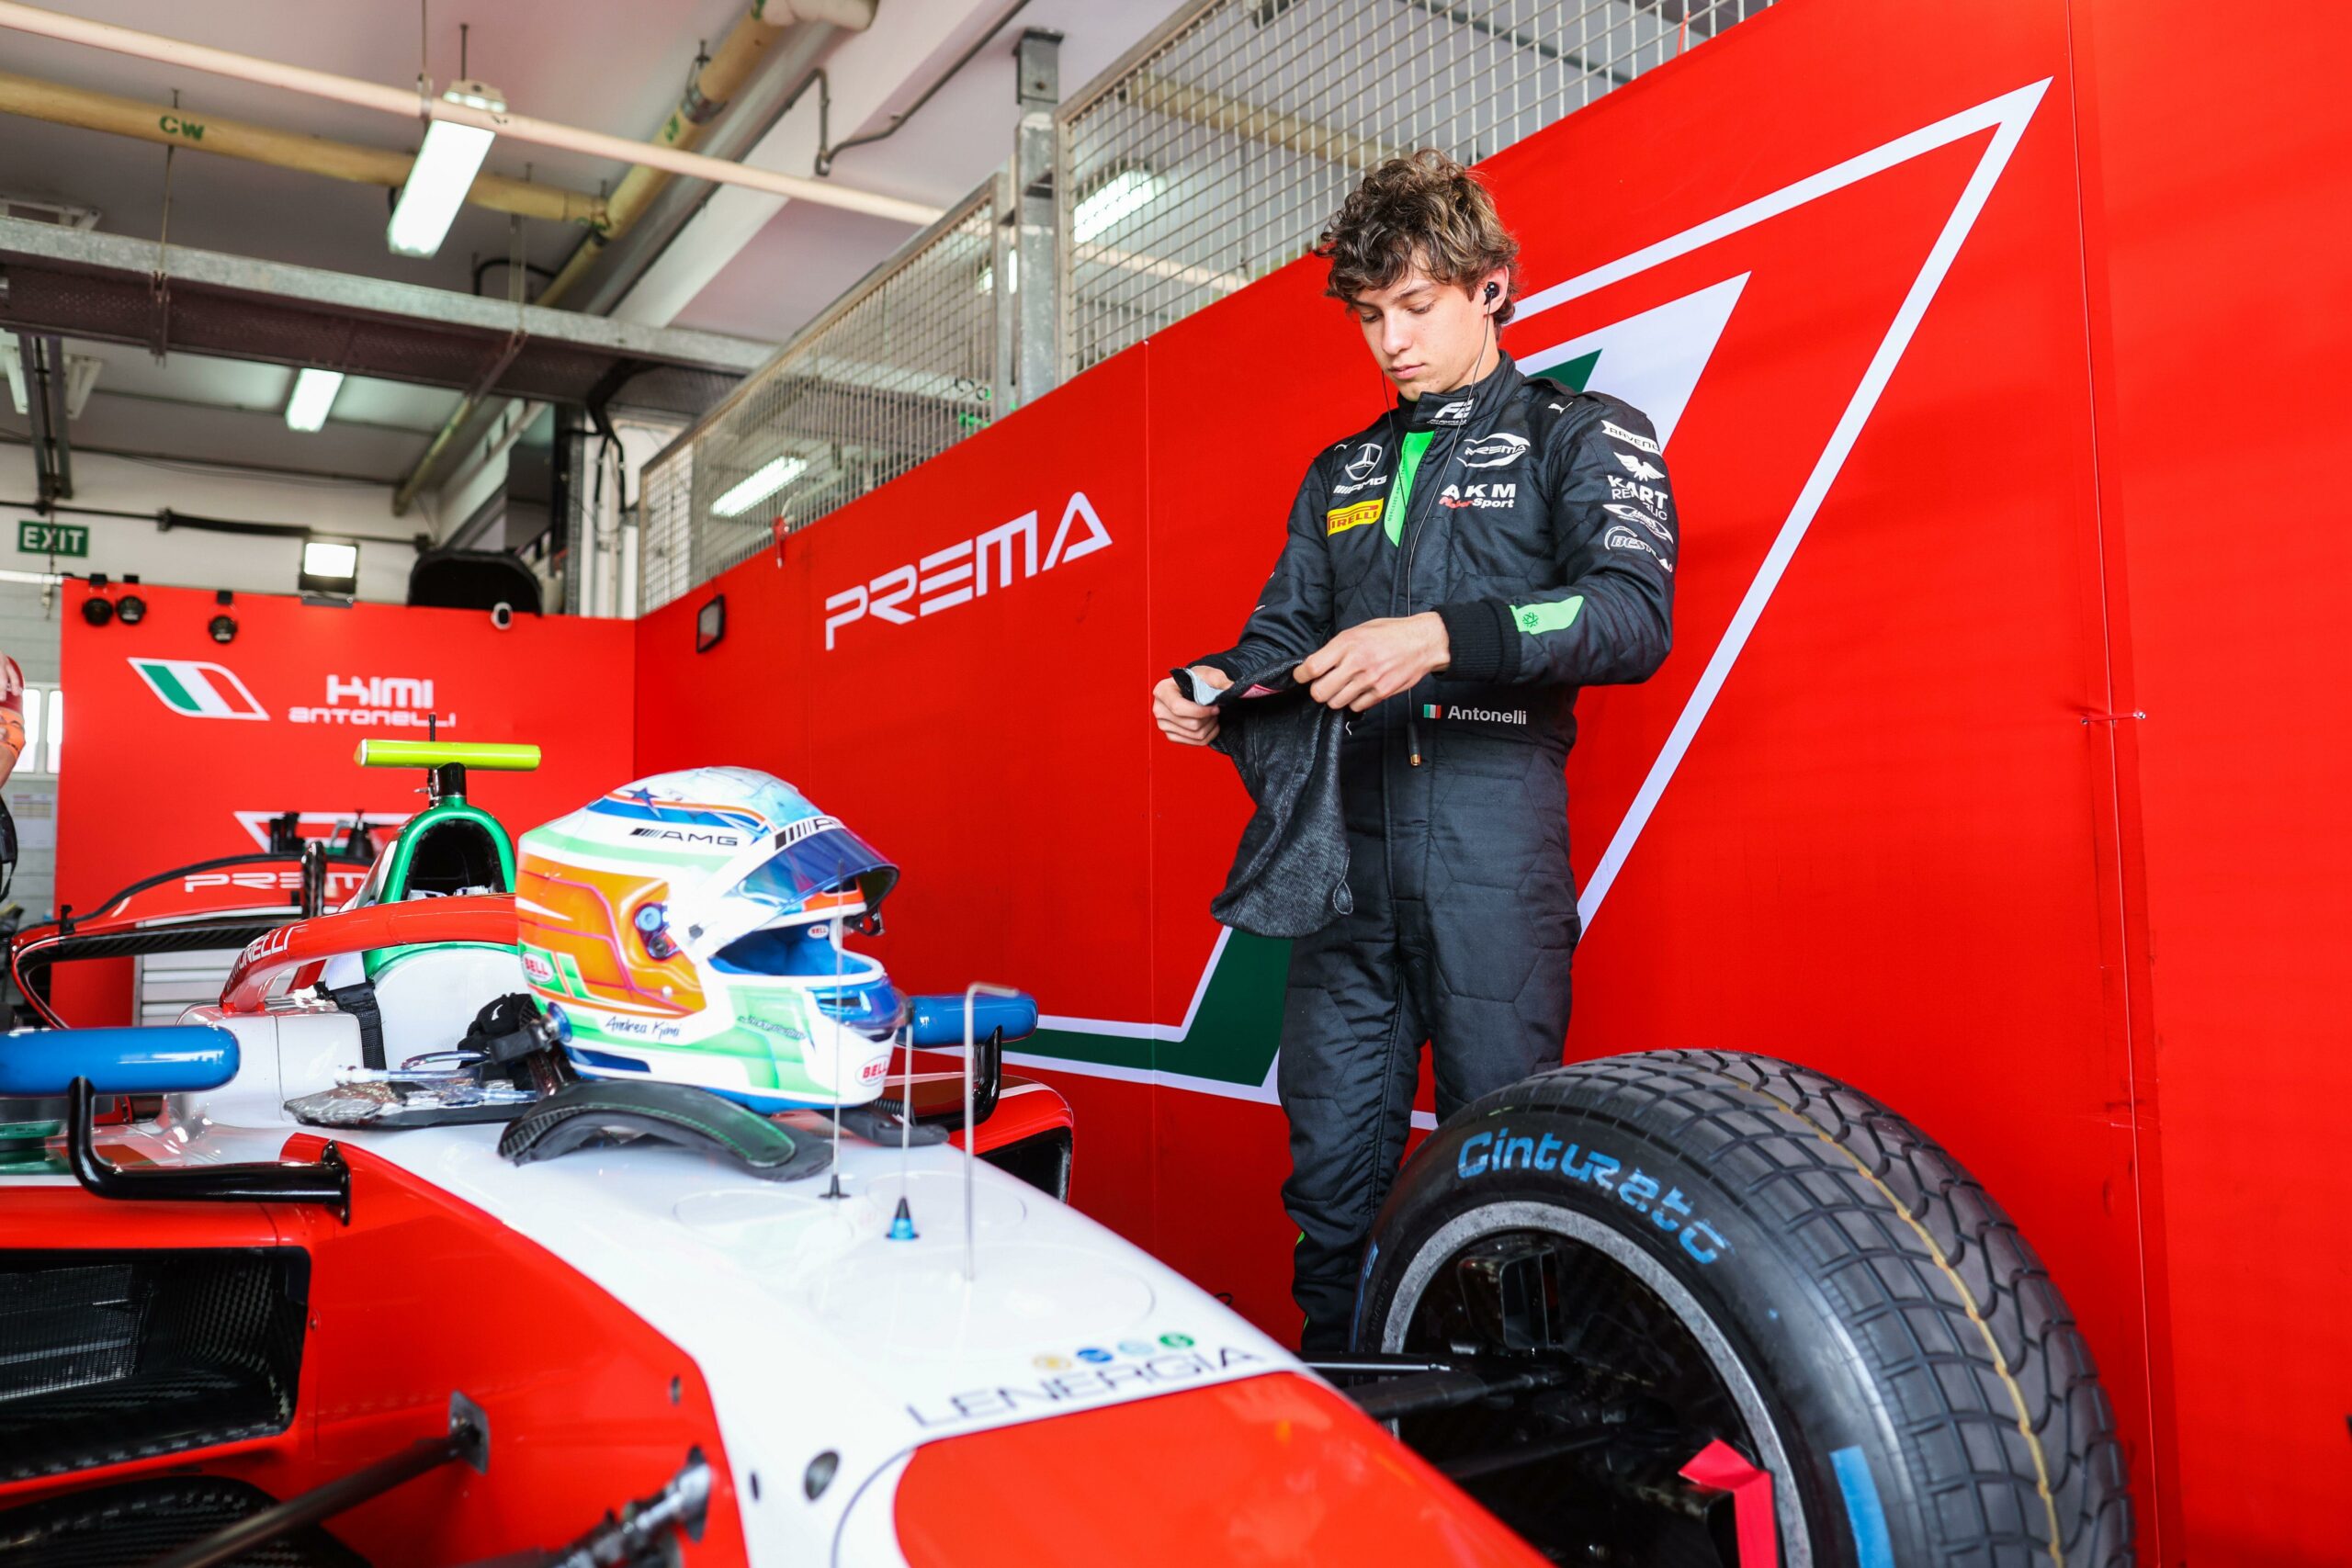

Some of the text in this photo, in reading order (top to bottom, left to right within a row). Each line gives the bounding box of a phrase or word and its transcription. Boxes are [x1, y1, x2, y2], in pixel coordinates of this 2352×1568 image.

[159, 116, 205, 141] CW
[1607, 475, 1668, 511] KART
[1328, 504, 1379, 531] PIRELLI
[23, 528, 85, 553] EXIT
[826, 491, 1113, 650] PREMA
[326, 674, 434, 709] KIMI
[1448, 705, 1526, 725] Antonelli
[661, 830, 738, 846] AMG
[185, 872, 368, 893] PREM
[525, 956, 549, 976] BELL
[863, 1059, 888, 1078] BELL
[1458, 1127, 1735, 1265] Cinturato
[906, 1348, 1268, 1427] LENERGIA
